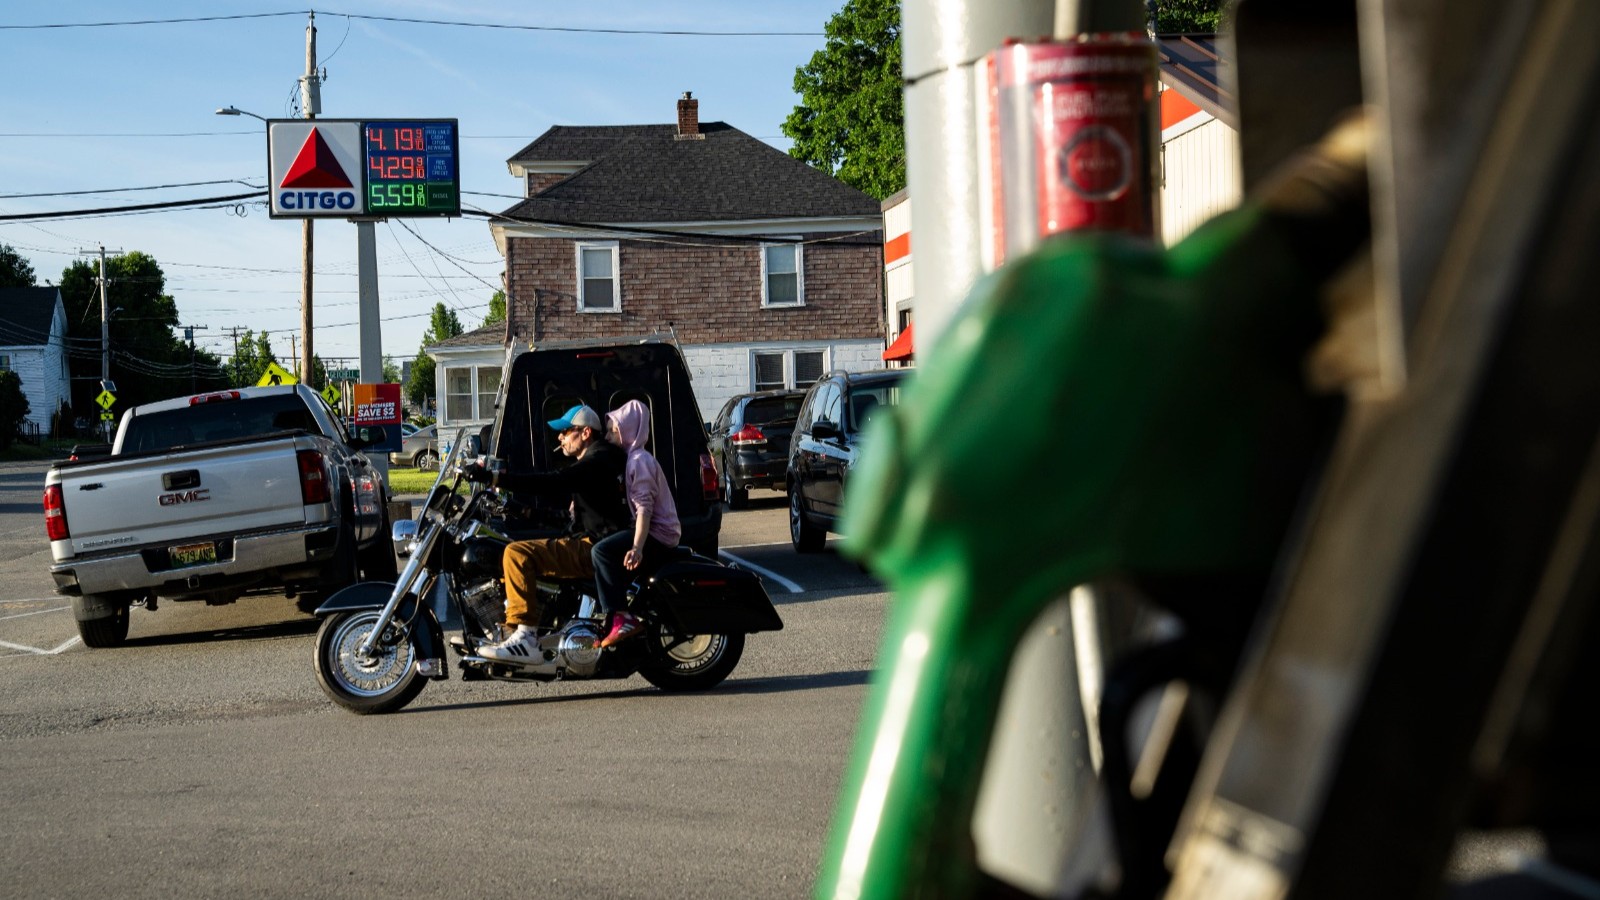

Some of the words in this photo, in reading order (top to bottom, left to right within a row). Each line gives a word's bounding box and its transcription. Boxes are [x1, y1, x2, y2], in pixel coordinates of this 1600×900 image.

[370, 156, 415, 179] 4.29
[280, 191, 355, 210] CITGO
[371, 184, 415, 207] 5.59
[357, 409, 381, 418] SAVE
[383, 407, 395, 416] $2
[158, 489, 211, 506] GMC
